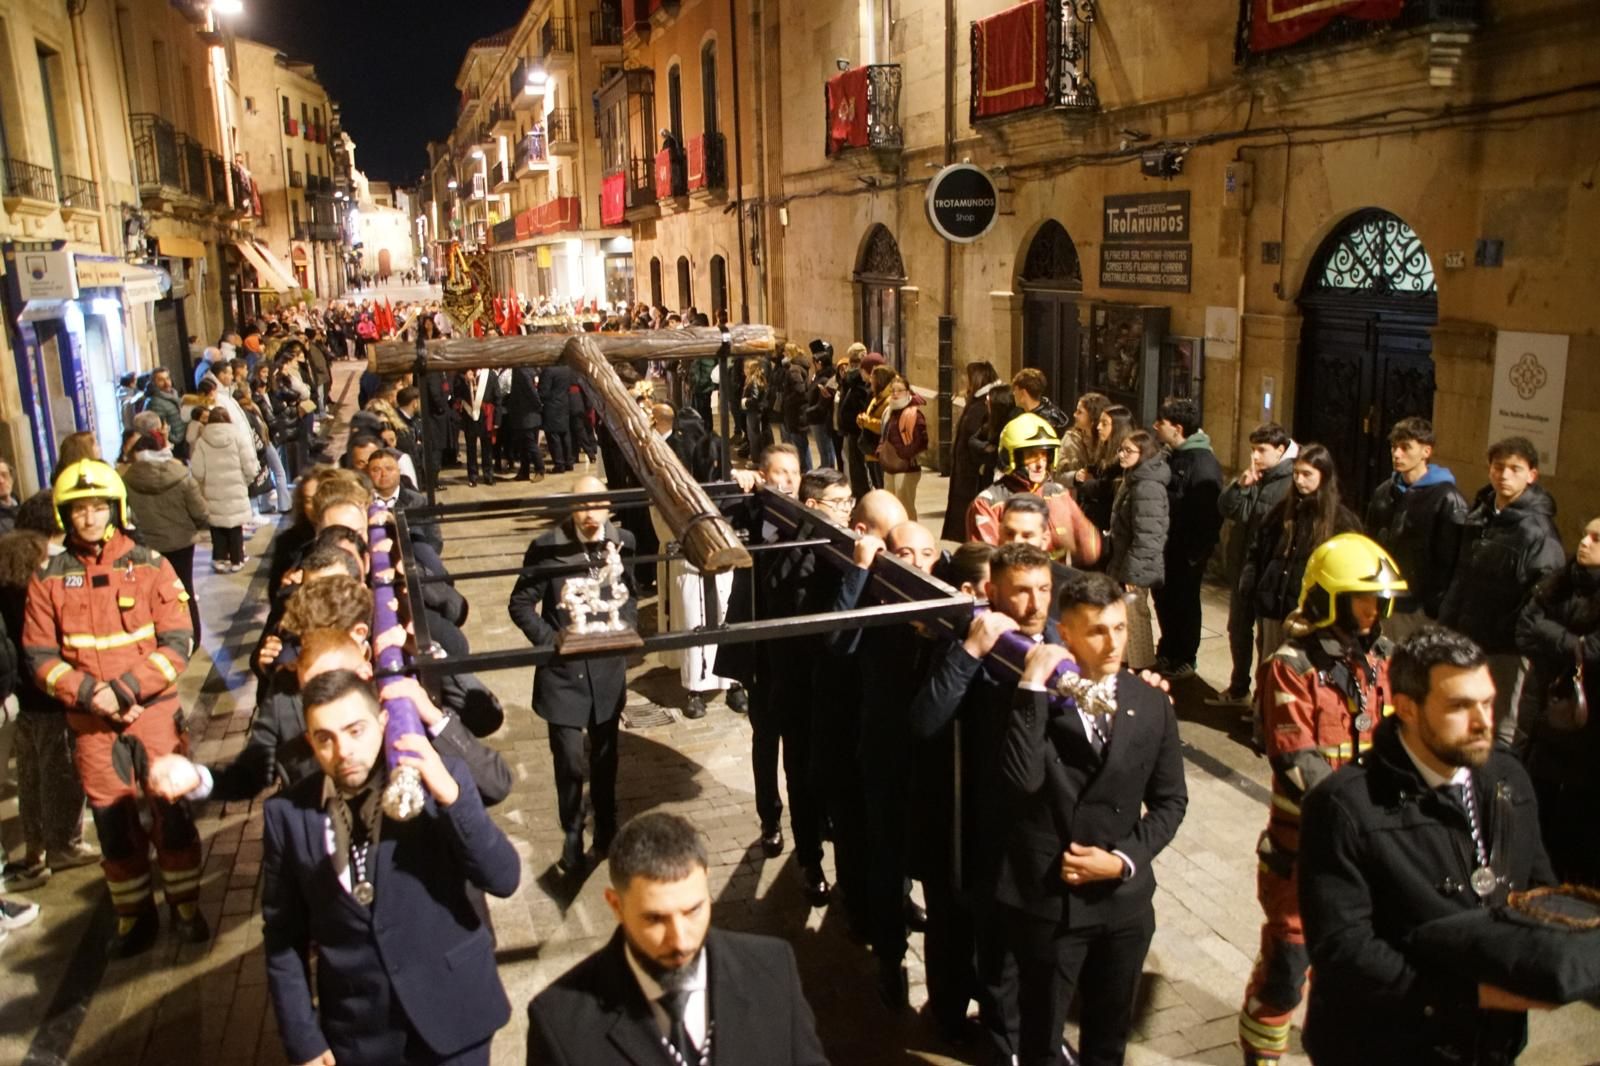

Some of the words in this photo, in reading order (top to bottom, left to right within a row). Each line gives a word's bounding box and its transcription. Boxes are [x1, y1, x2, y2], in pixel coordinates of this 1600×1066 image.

[935, 199, 994, 208] TROTAMUNDOS
[955, 213, 974, 223] Shop
[65, 575, 83, 588] 220
